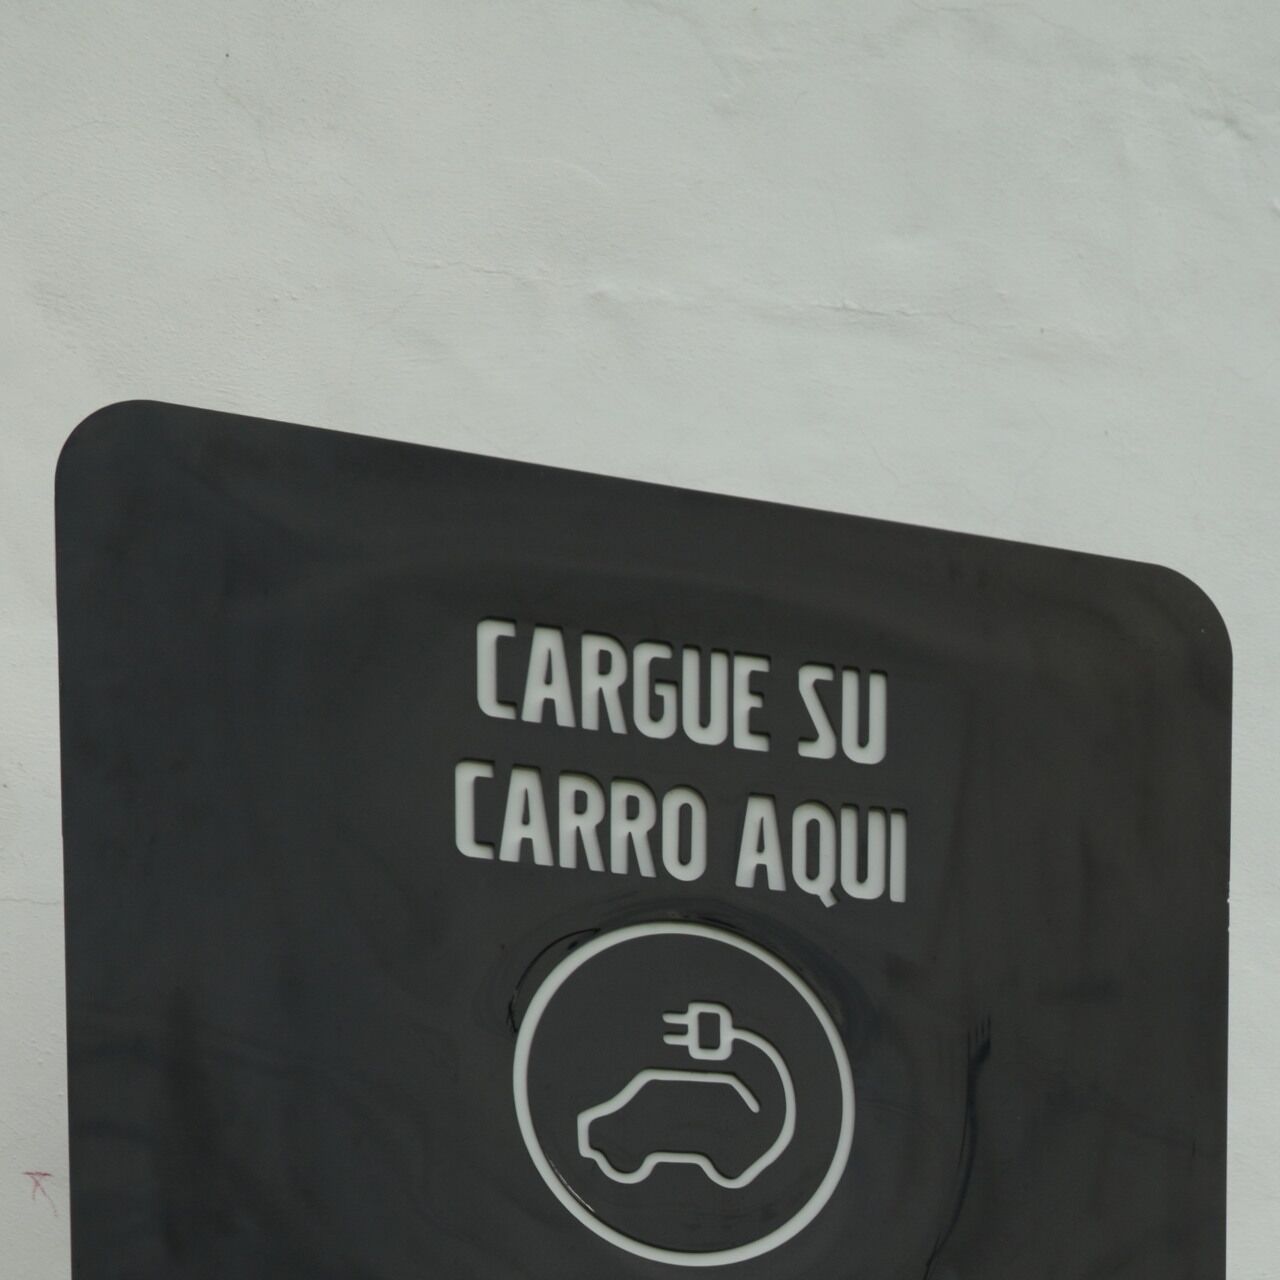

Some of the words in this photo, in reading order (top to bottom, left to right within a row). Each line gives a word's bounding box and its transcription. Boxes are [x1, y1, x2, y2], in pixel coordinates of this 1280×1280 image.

[476, 617, 770, 752] CARGUE
[797, 662, 888, 765] SU
[454, 759, 708, 882] CARRO
[735, 794, 907, 908] AQUI
